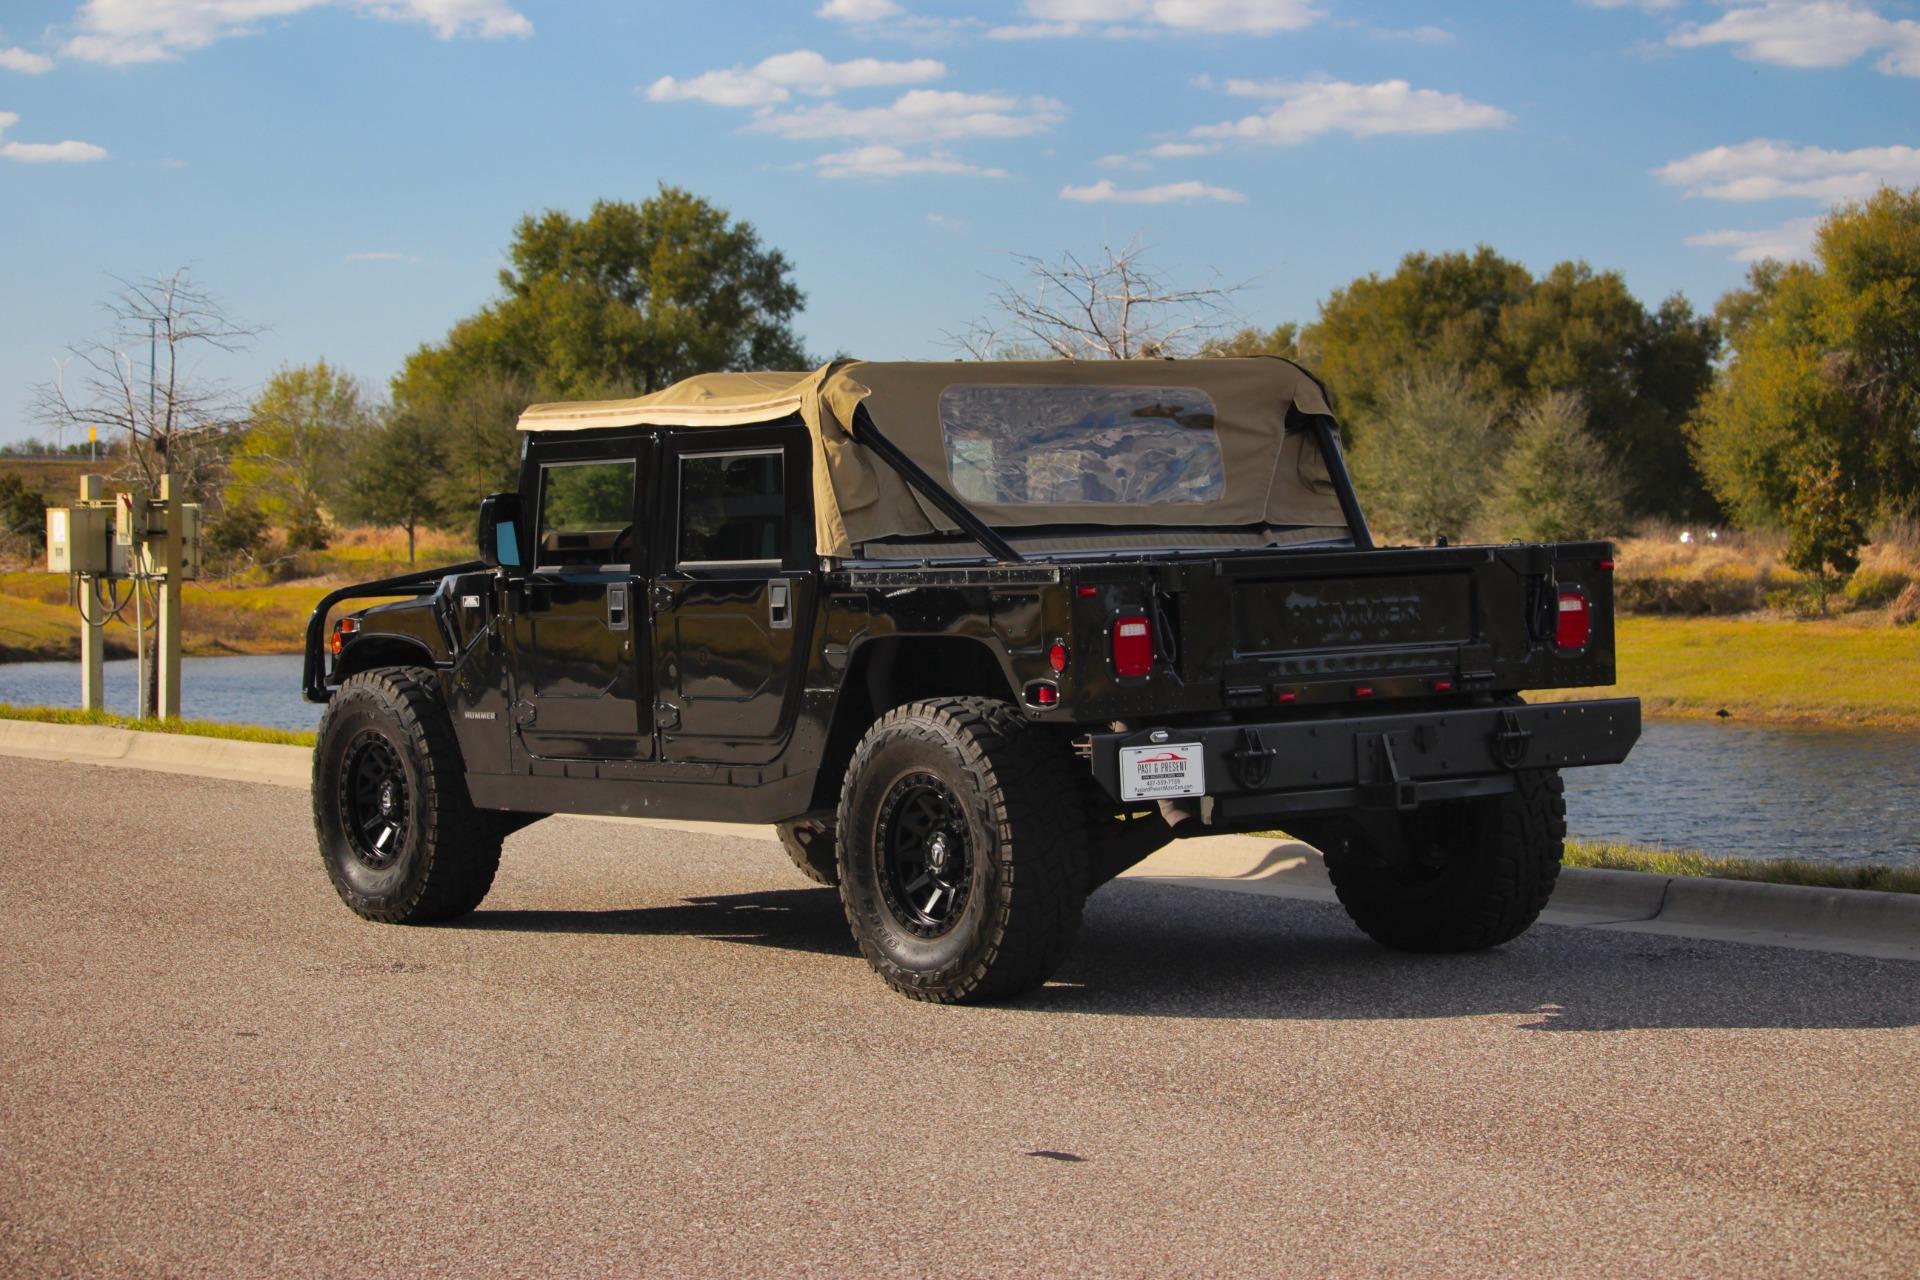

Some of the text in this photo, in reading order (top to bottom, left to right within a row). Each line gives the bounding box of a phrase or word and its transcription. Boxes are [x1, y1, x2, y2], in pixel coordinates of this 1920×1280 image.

[464, 711, 496, 720] HUMMER
[1137, 764, 1152, 774] PAST
[1161, 761, 1187, 773] PRESENT
